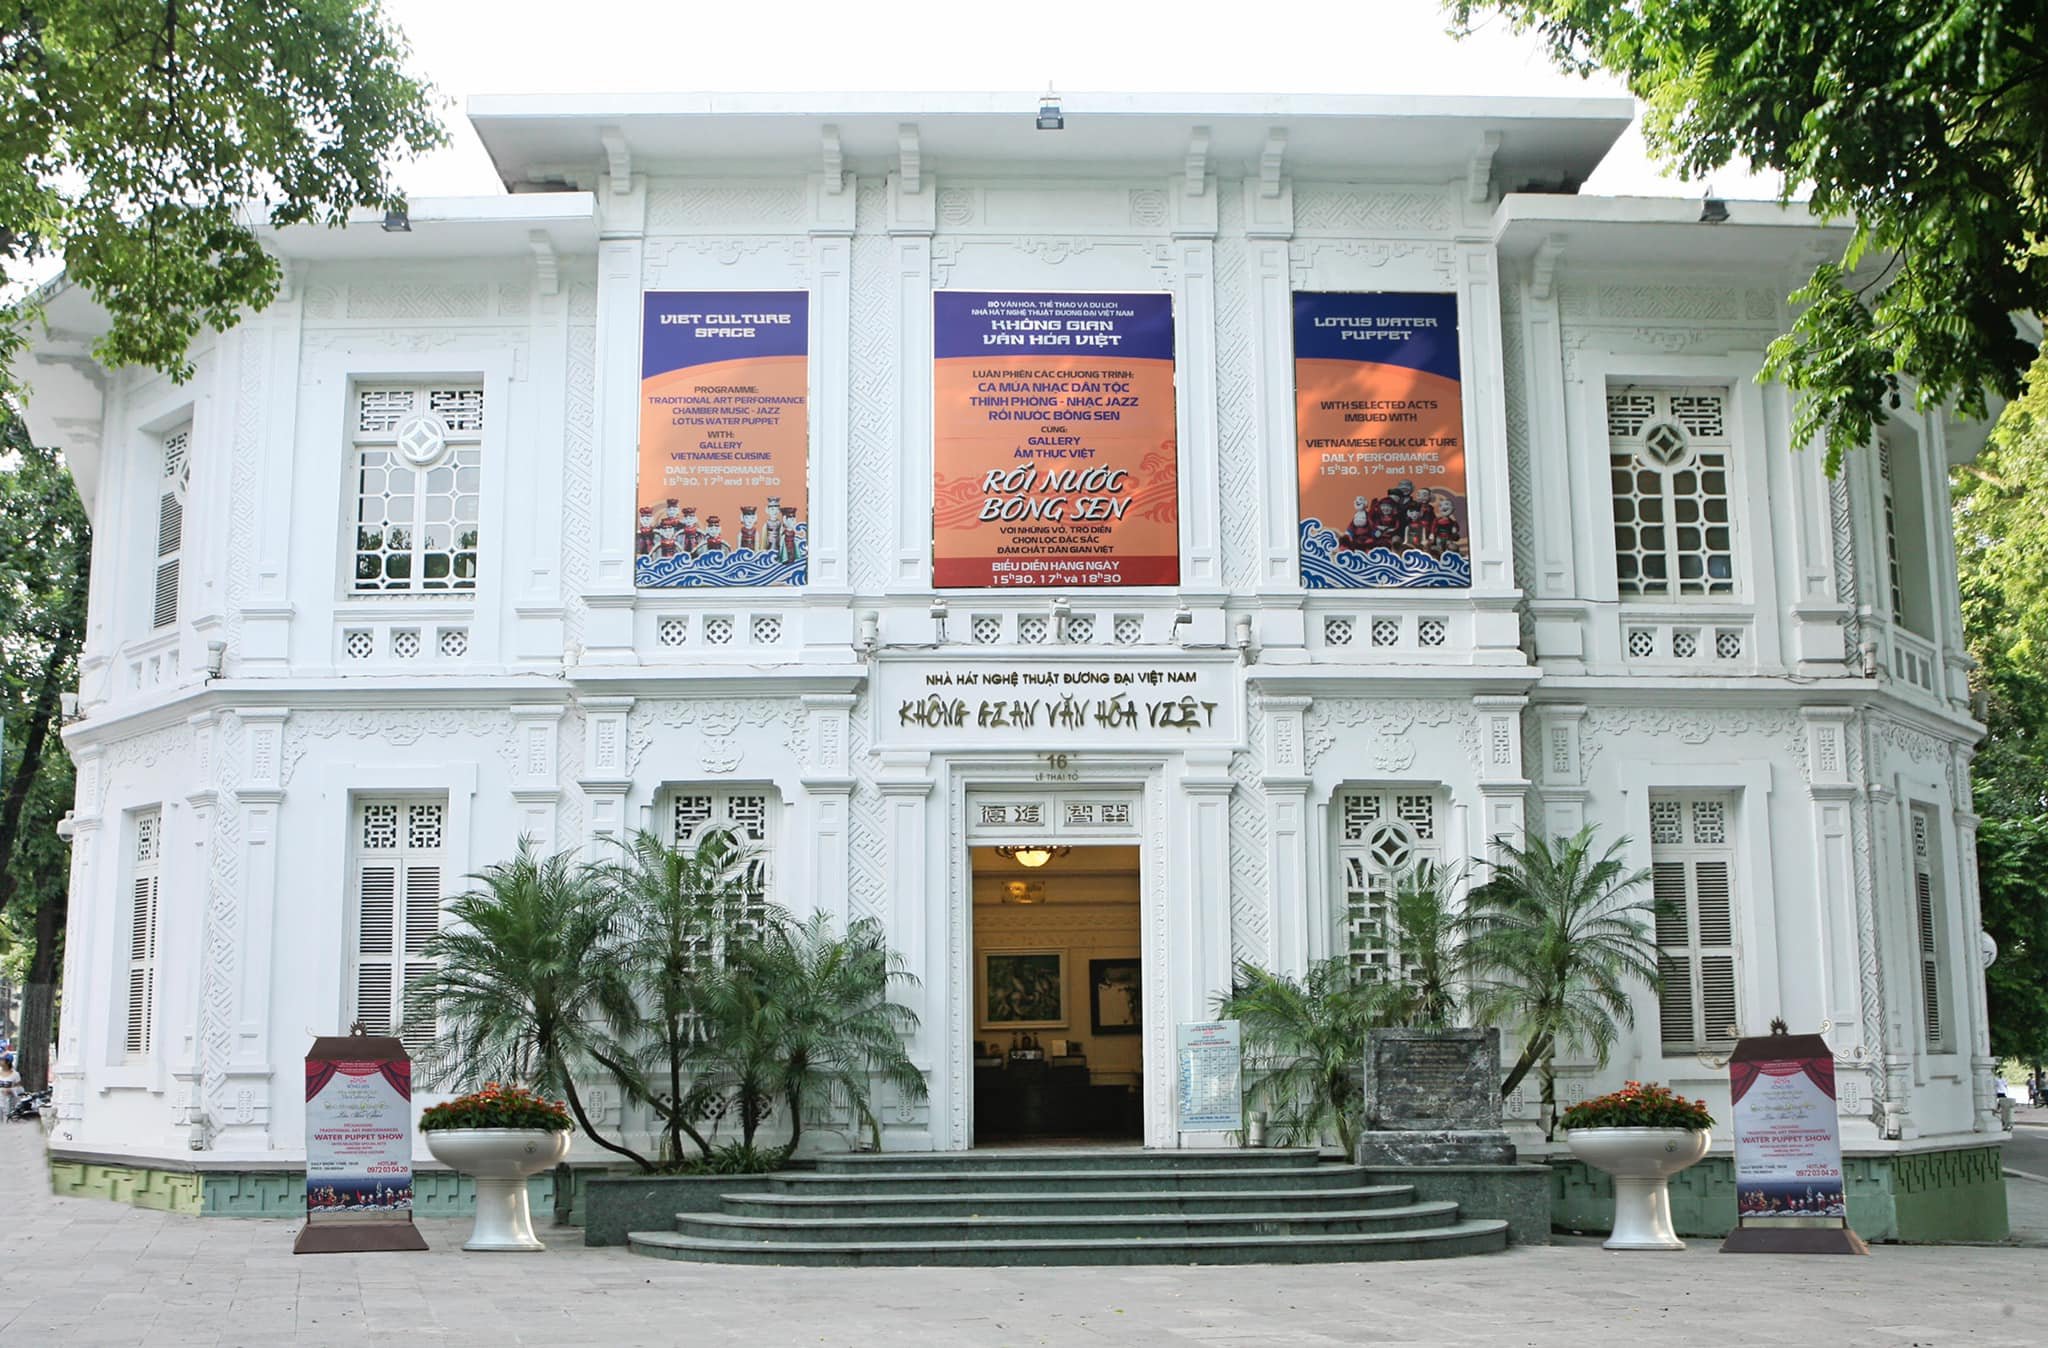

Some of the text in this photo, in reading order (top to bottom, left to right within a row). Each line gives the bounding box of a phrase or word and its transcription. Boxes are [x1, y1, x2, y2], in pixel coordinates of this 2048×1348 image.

[1115, 309, 1134, 317] NAM
[660, 314, 791, 324] VIET CULTURE
[991, 317, 1113, 331] KHÔNG GIAN
[1314, 317, 1438, 327] LOTUS WATER
[695, 328, 756, 338] SPACE
[1341, 331, 1412, 340] PUPPET
[982, 331, 1122, 348] VĂN HÓA VIỆT
[694, 386, 758, 394] PROGRAMME:
[978, 381, 1129, 394] CA MÚA NHẠC DÂN TỘC
[648, 396, 805, 405] TRADITIONAL ART PERFORMANCE
[1066, 397, 1103, 408] NHẠC
[1105, 397, 1139, 407] JAZZ
[1321, 400, 1438, 410] WITH SELECTED ACTS
[672, 407, 718, 415] CHAMBER
[720, 407, 749, 415] MUSIC
[756, 407, 780, 415] JAZZ
[988, 407, 1012, 421] RỐI
[1053, 409, 1092, 421] BÔNG
[1093, 410, 1120, 421] SEN
[672, 417, 779, 425] LOTUS WATER PUPPET
[1344, 413, 1417, 422] IMBUED WITH
[707, 431, 735, 439] WITH:
[699, 441, 743, 449] GALLERY
[1028, 436, 1081, 446] GALLERY
[1305, 438, 1457, 448] VIETNAMESE FOLK CULTURE
[671, 452, 771, 460] VIETNAMESE CUISINE
[1068, 448, 1096, 459] VIỆT
[1321, 452, 1439, 462] DAILY PERFORMANCE
[665, 466, 774, 474] DAILY PERFORMANCE
[1386, 465, 1405, 475] and
[724, 478, 742, 486] and
[982, 461, 1128, 494] RỐI NƯỚC
[978, 492, 1133, 522] BÔNG SEN
[992, 558, 1120, 571] BIỂU DIỄN HÀNG NGÀY
[1063, 574, 1078, 583] và
[926, 670, 1197, 687] NHÀ HÁT NGHỆ THUẬT ĐƯƠNG ĐẠI VIỆT NAM
[898, 692, 1218, 733] KHÔNG GIAN VĂN HÓA VIỆT
[1046, 754, 1068, 769] 16
[1742, 1136, 1770, 1144] WATER
[1804, 1134, 1832, 1142] SHOW
